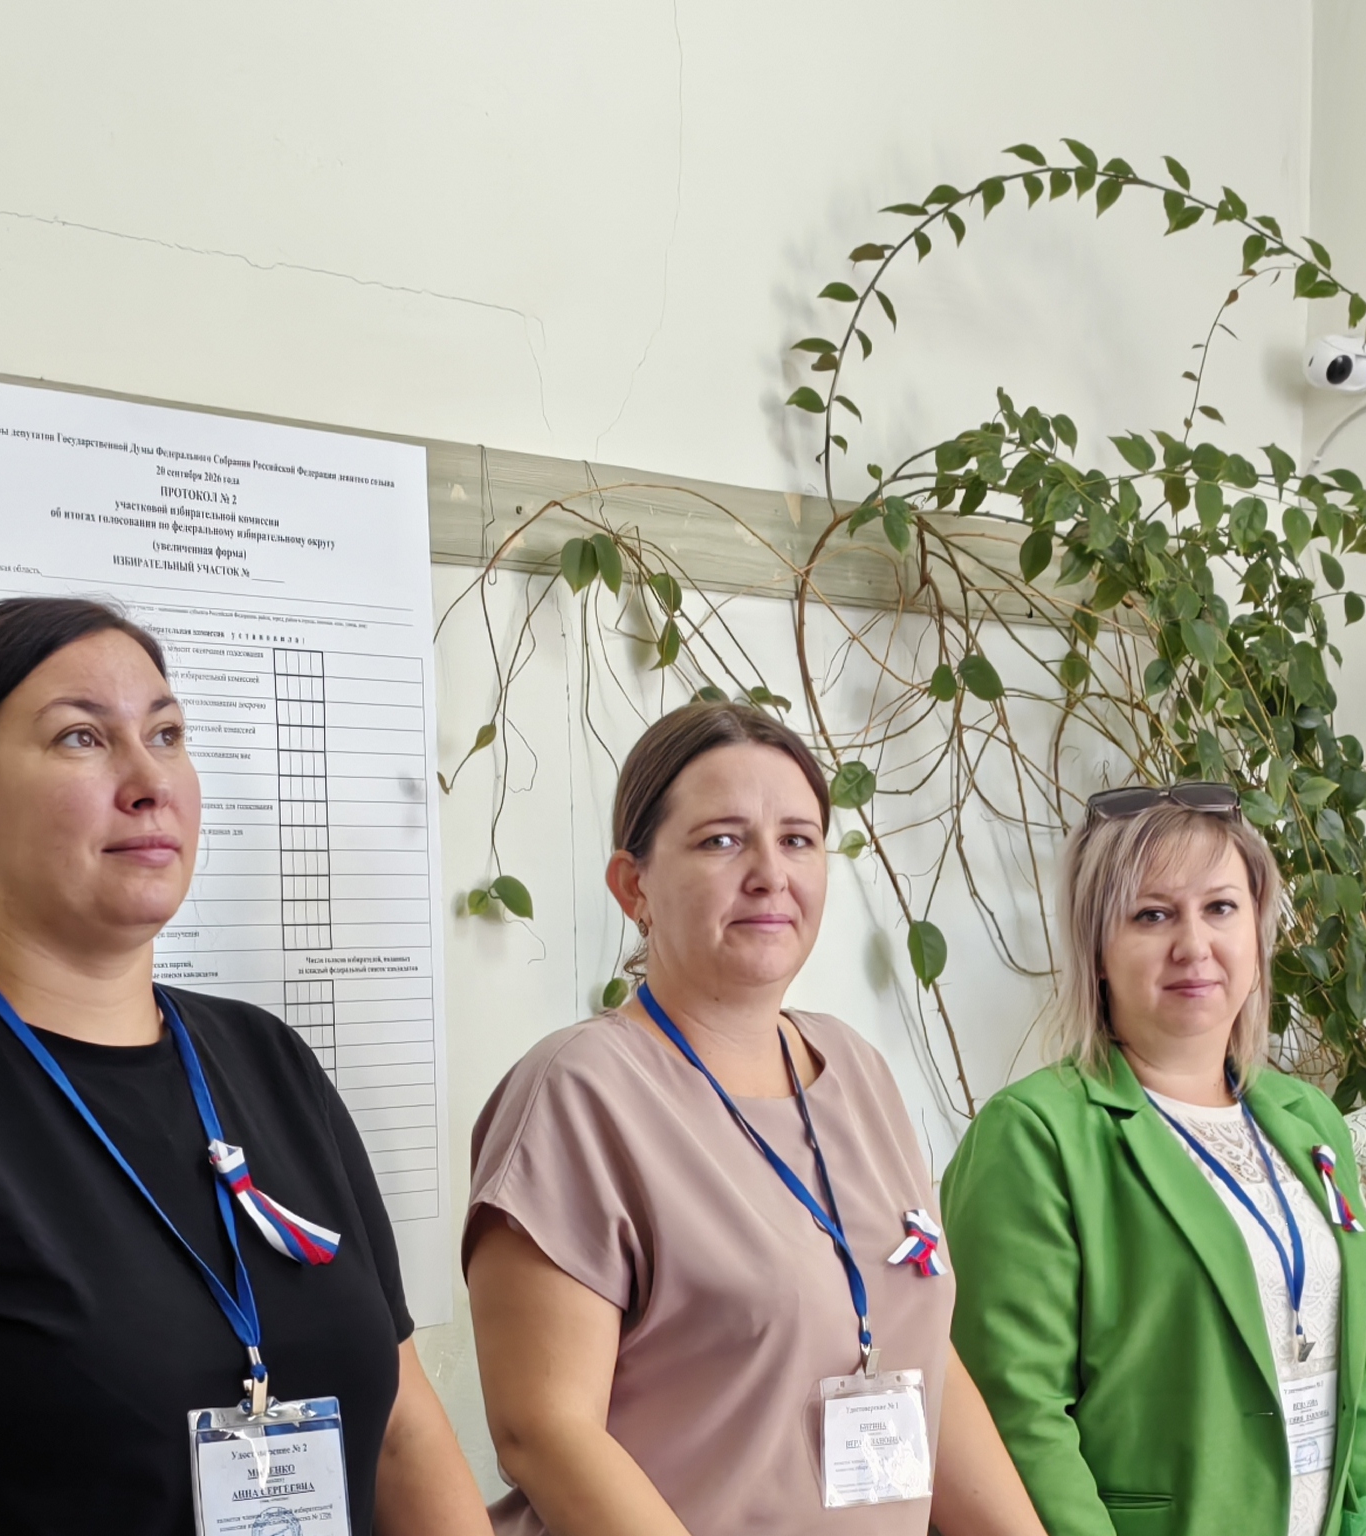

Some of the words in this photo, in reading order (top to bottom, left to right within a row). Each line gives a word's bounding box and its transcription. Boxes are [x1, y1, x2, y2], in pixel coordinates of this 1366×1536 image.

[10, 429, 55, 442] депутатов
[56, 432, 128, 452] Государственной
[128, 443, 154, 456] Думы
[155, 447, 211, 463] Федерального
[212, 454, 251, 468] Собрания
[252, 460, 295, 474] Российской
[296, 466, 337, 480] Федерации
[155, 465, 166, 476] 20
[165, 469, 202, 482] сентября
[203, 471, 222, 483] 2026
[222, 476, 240, 485] года
[159, 486, 218, 503] ПРОТОКОЛ
[114, 501, 168, 514] участковой
[169, 505, 236, 522] избирательной
[237, 515, 280, 528] комиссии
[49, 506, 62, 518] об
[63, 511, 96, 522] итогах
[97, 515, 157, 529] голосования
[157, 521, 170, 531] по
[170, 520, 234, 539] федеральному
[236, 528, 305, 547] избирательному
[306, 538, 335, 551] округу
[151, 541, 213, 556] (увеличенная
[214, 546, 247, 560] форма)
[112, 555, 195, 572] ИЗБИРАТЕЛЬНЫЙ
[196, 563, 240, 577] УЧАСТОК
[240, 567, 250, 578] №
[232, 1487, 259, 1500] АННА
[260, 1482, 315, 1496] СЕРГЕЕВНА
